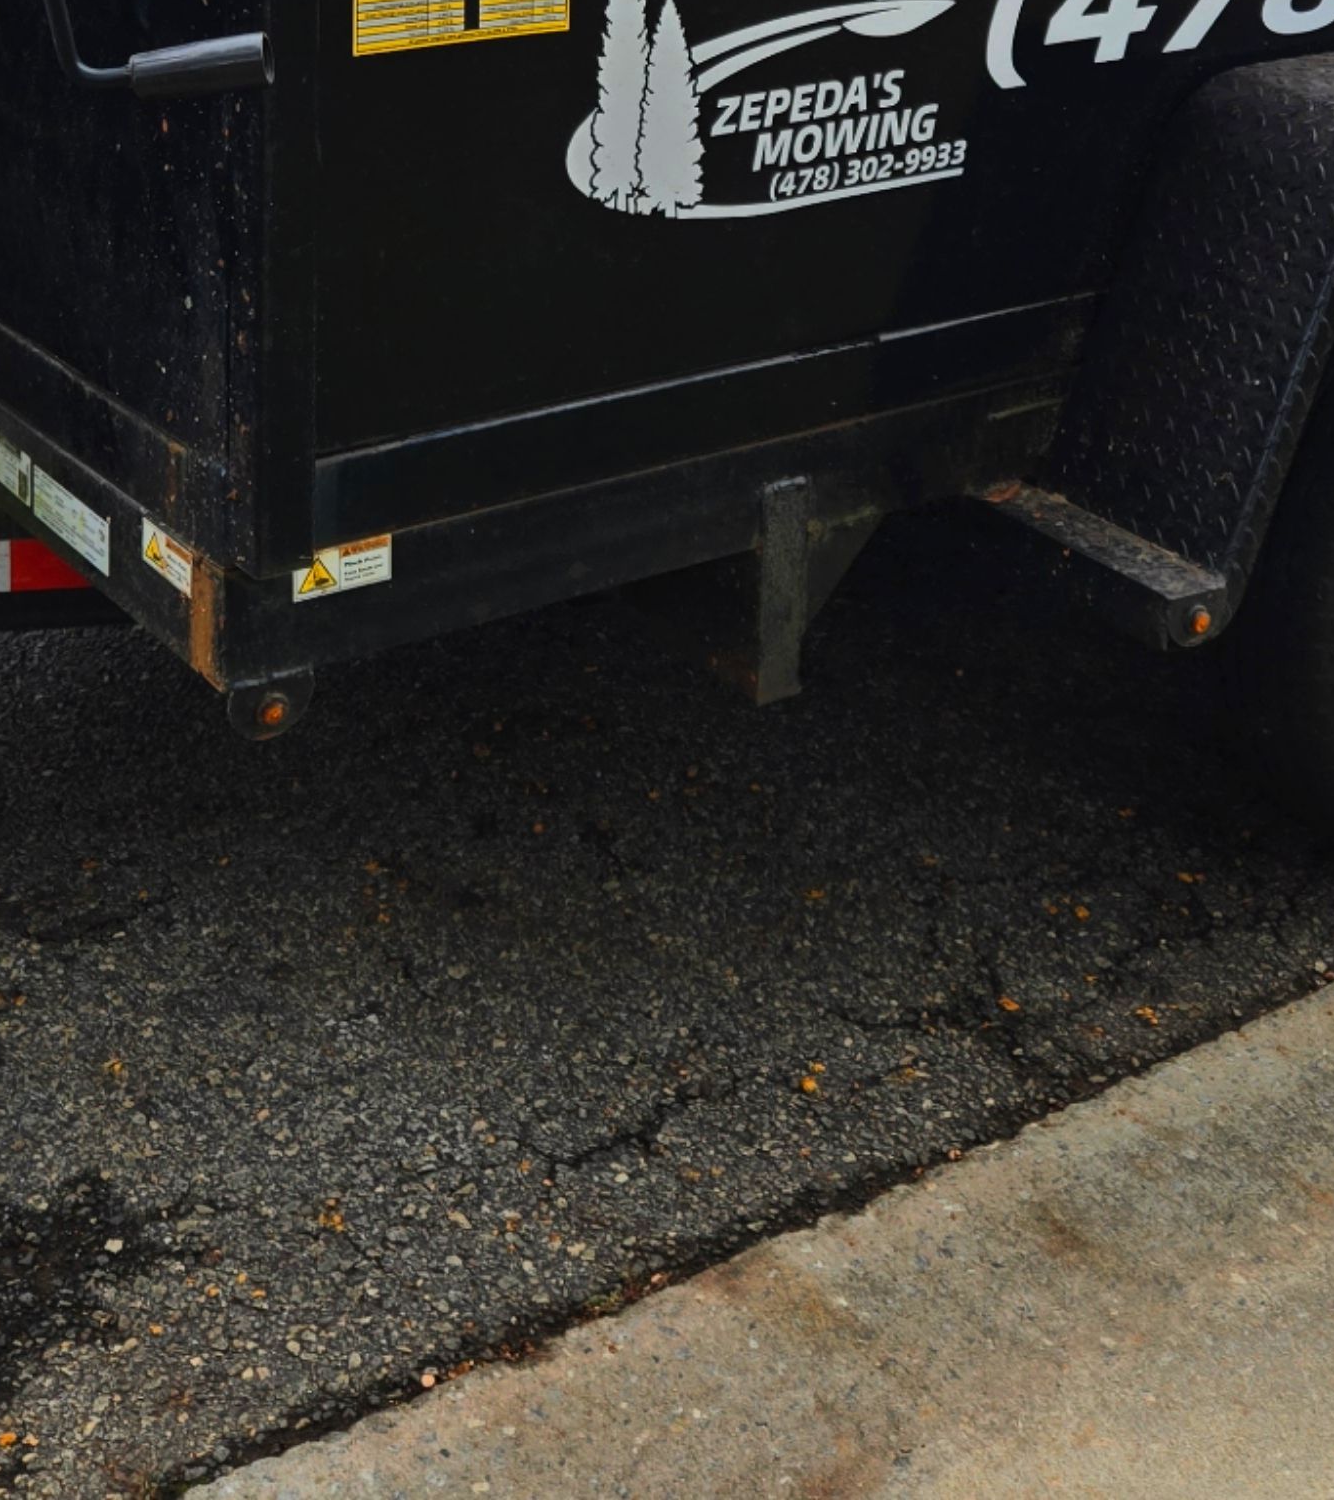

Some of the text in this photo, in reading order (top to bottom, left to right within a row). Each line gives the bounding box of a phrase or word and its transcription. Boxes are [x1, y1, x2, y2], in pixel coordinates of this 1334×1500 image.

[710, 69, 905, 137] ZEPEDA'S
[752, 103, 939, 172] MOWING
[769, 139, 967, 202] (478) 302-9933
